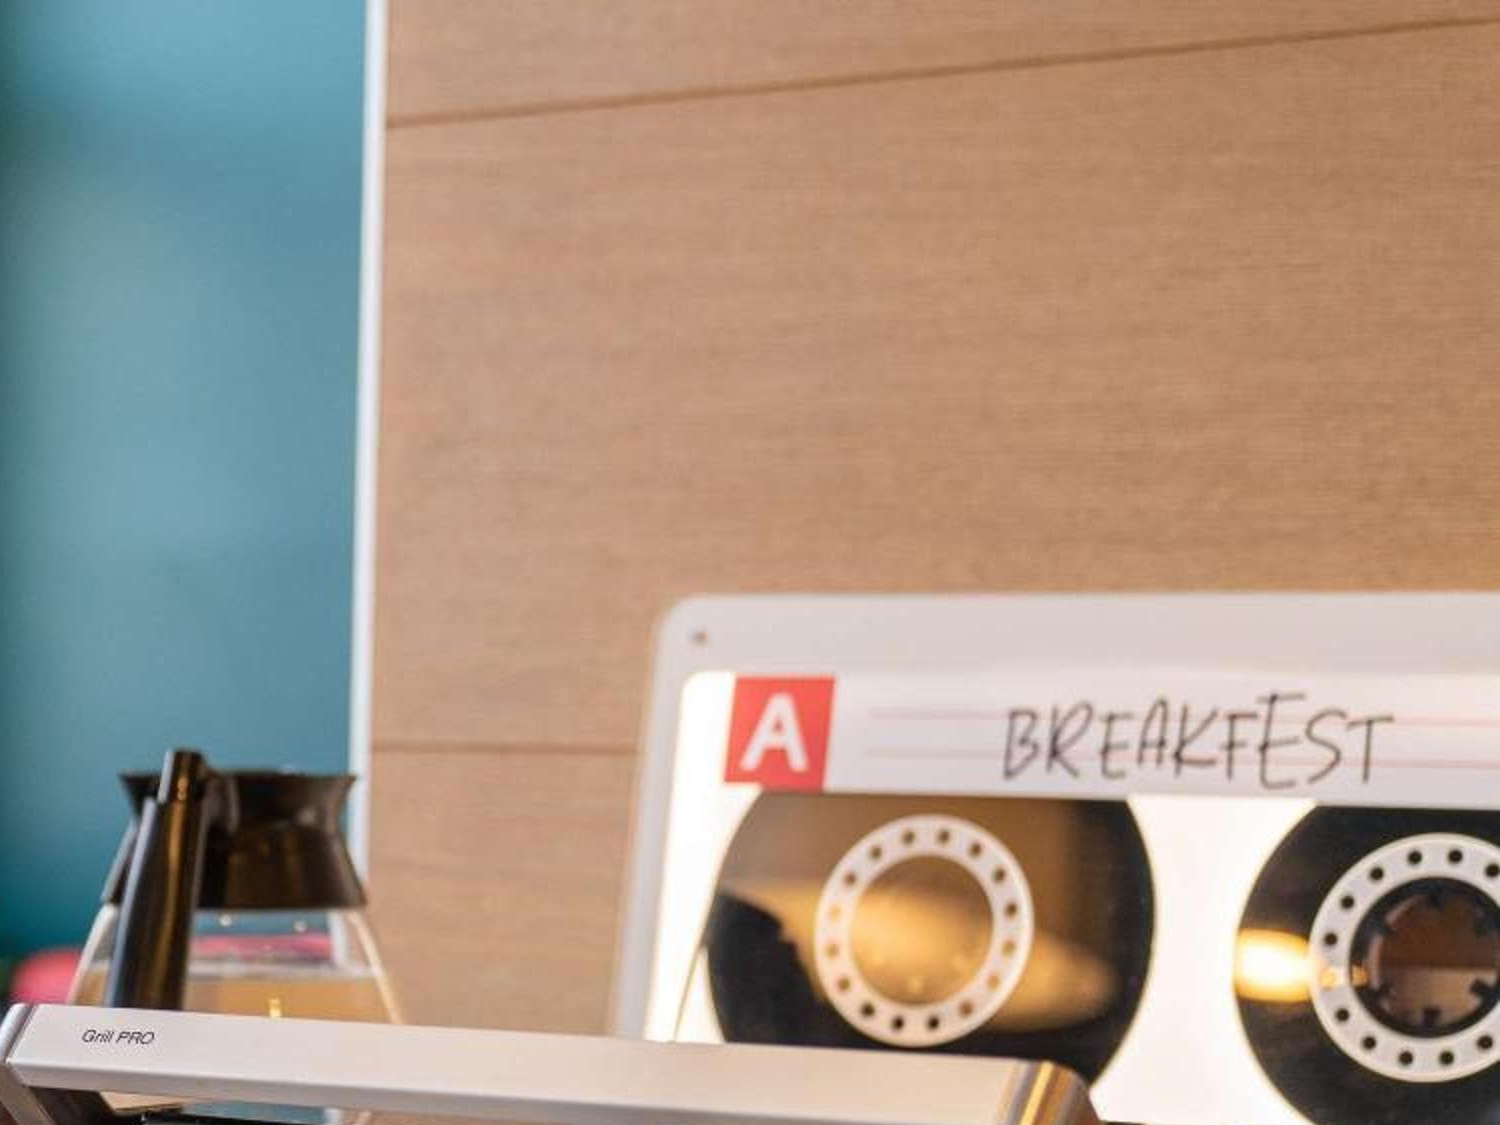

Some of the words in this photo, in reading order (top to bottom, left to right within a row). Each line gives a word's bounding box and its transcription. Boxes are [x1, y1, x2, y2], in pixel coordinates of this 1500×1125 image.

[739, 693, 808, 773] A
[1001, 692, 1394, 789] BREAKFEST
[81, 1029, 114, 1044] Grill
[115, 1030, 155, 1045] PRO
